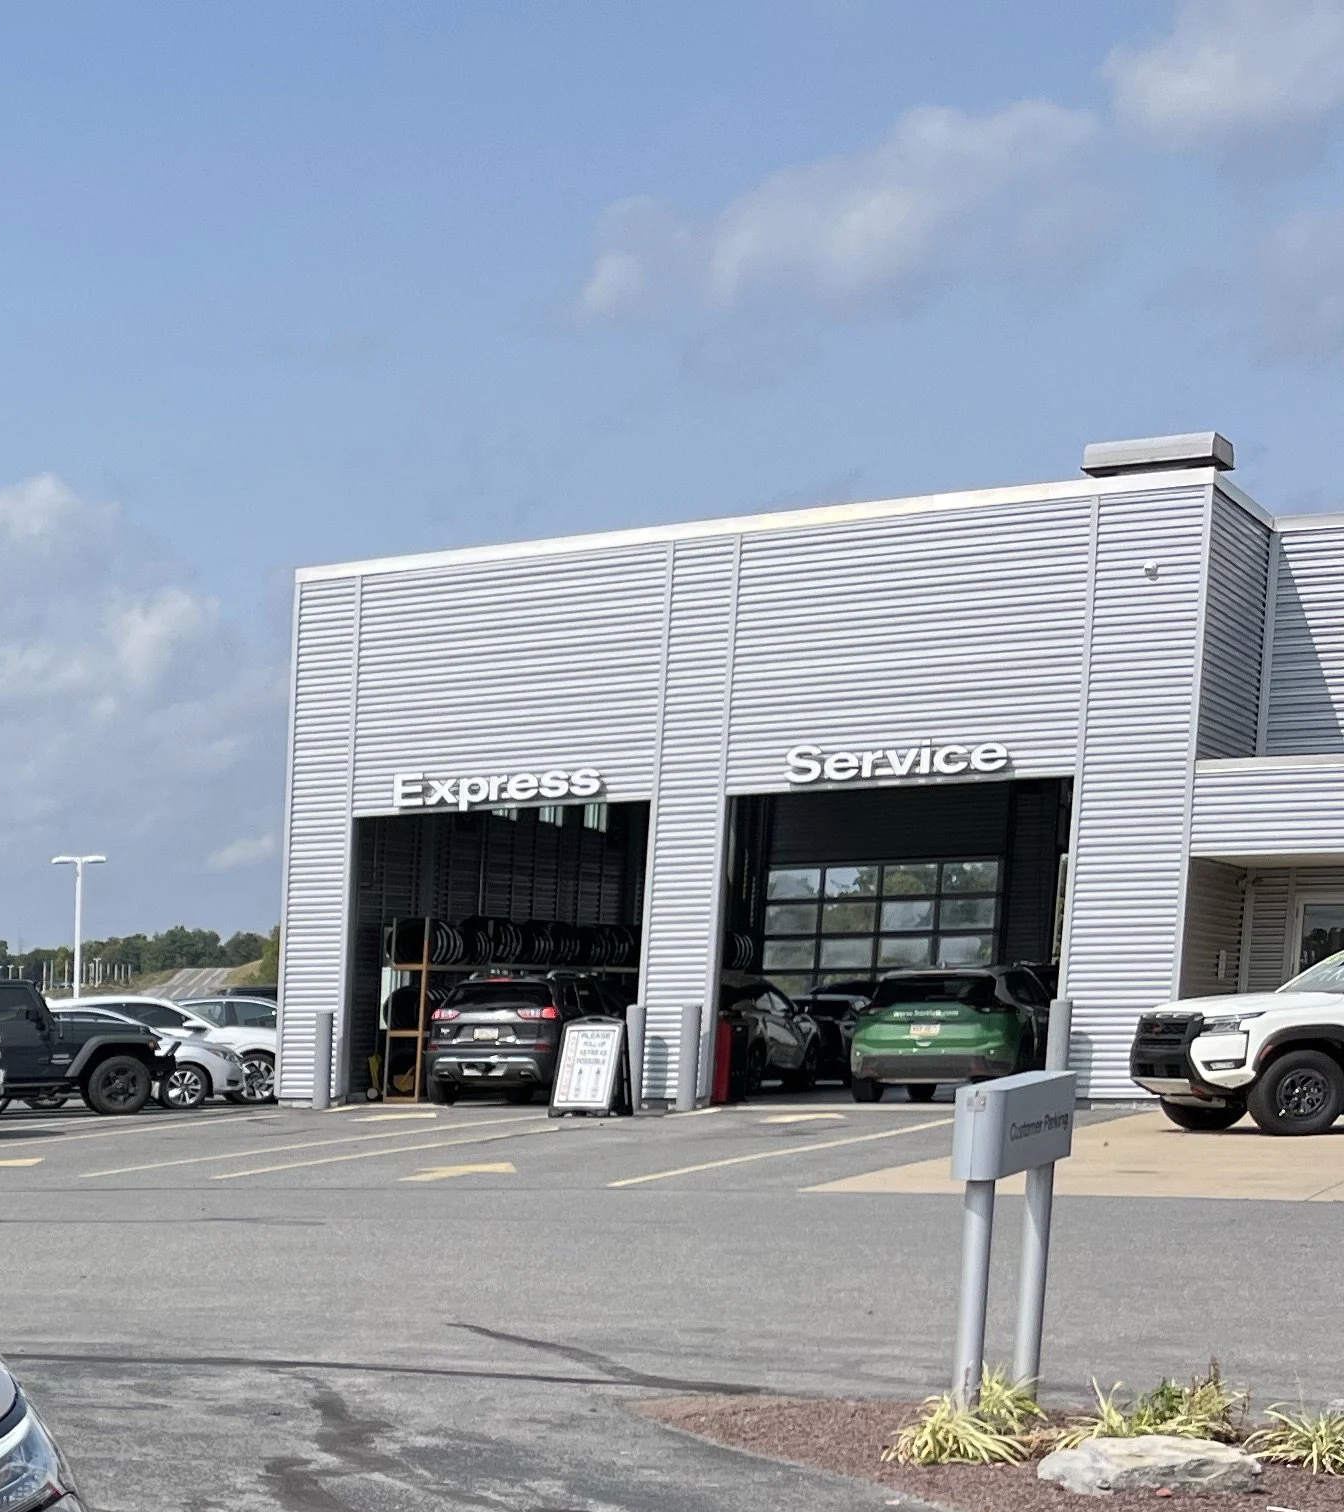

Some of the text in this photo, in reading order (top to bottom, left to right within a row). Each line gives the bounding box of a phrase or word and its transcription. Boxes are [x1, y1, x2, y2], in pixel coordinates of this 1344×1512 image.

[784, 737, 1009, 784] Service
[393, 767, 601, 811] Express
[580, 1032, 611, 1040] PLEASE
